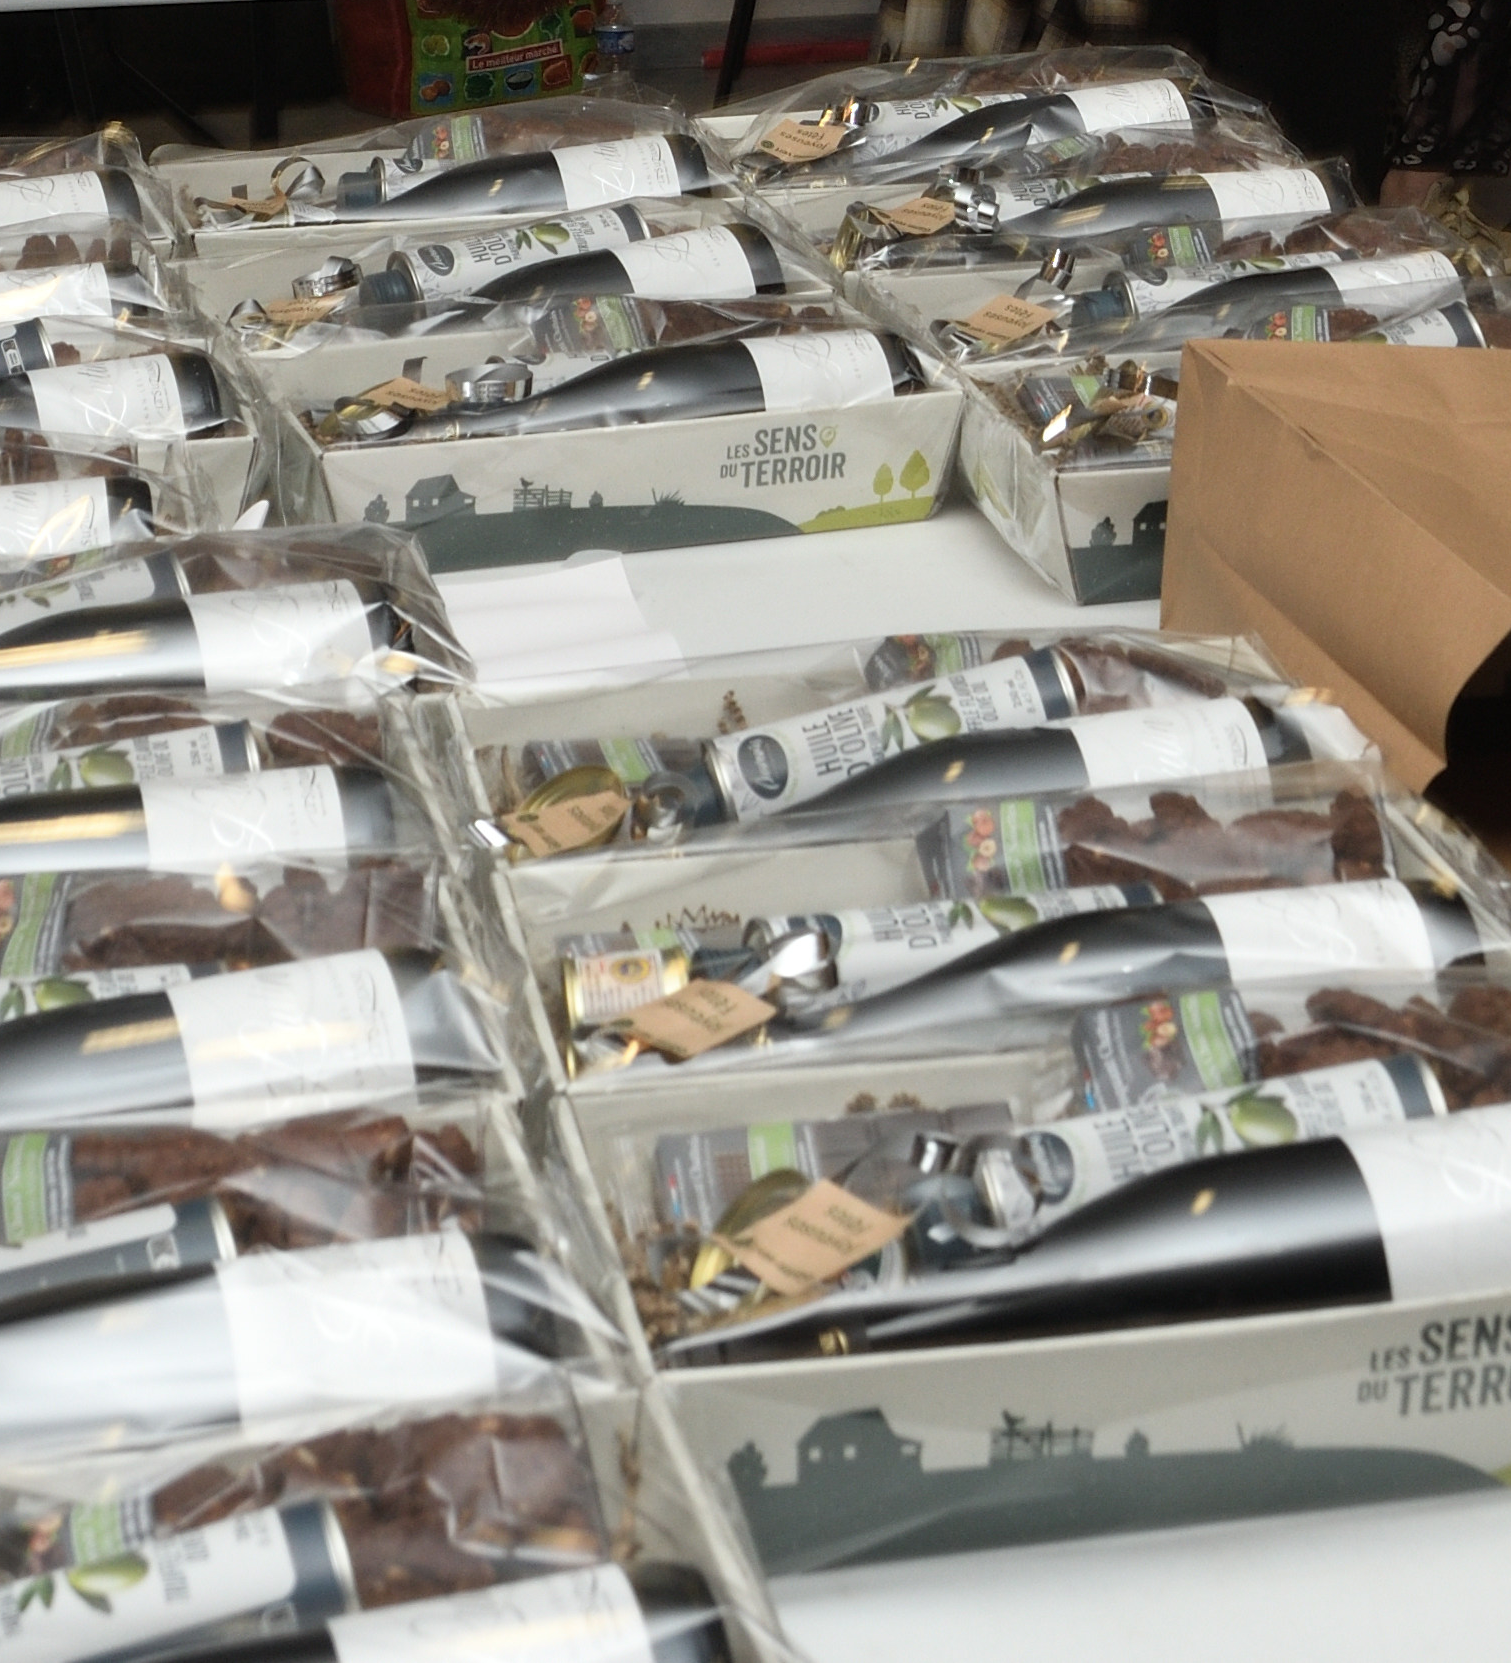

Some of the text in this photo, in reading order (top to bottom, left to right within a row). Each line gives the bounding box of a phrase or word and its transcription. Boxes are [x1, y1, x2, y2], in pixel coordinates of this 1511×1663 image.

[472, 45, 558, 70] Le meilleur marché
[779, 131, 829, 152] Joyeuses
[727, 424, 817, 460] LES SENS
[720, 452, 846, 488] DU TERROIR
[801, 719, 842, 777] HUILE
[1094, 1116, 1138, 1182] HUILE
[1370, 1345, 1411, 1372] LES
[1357, 1379, 1388, 1404] DU
